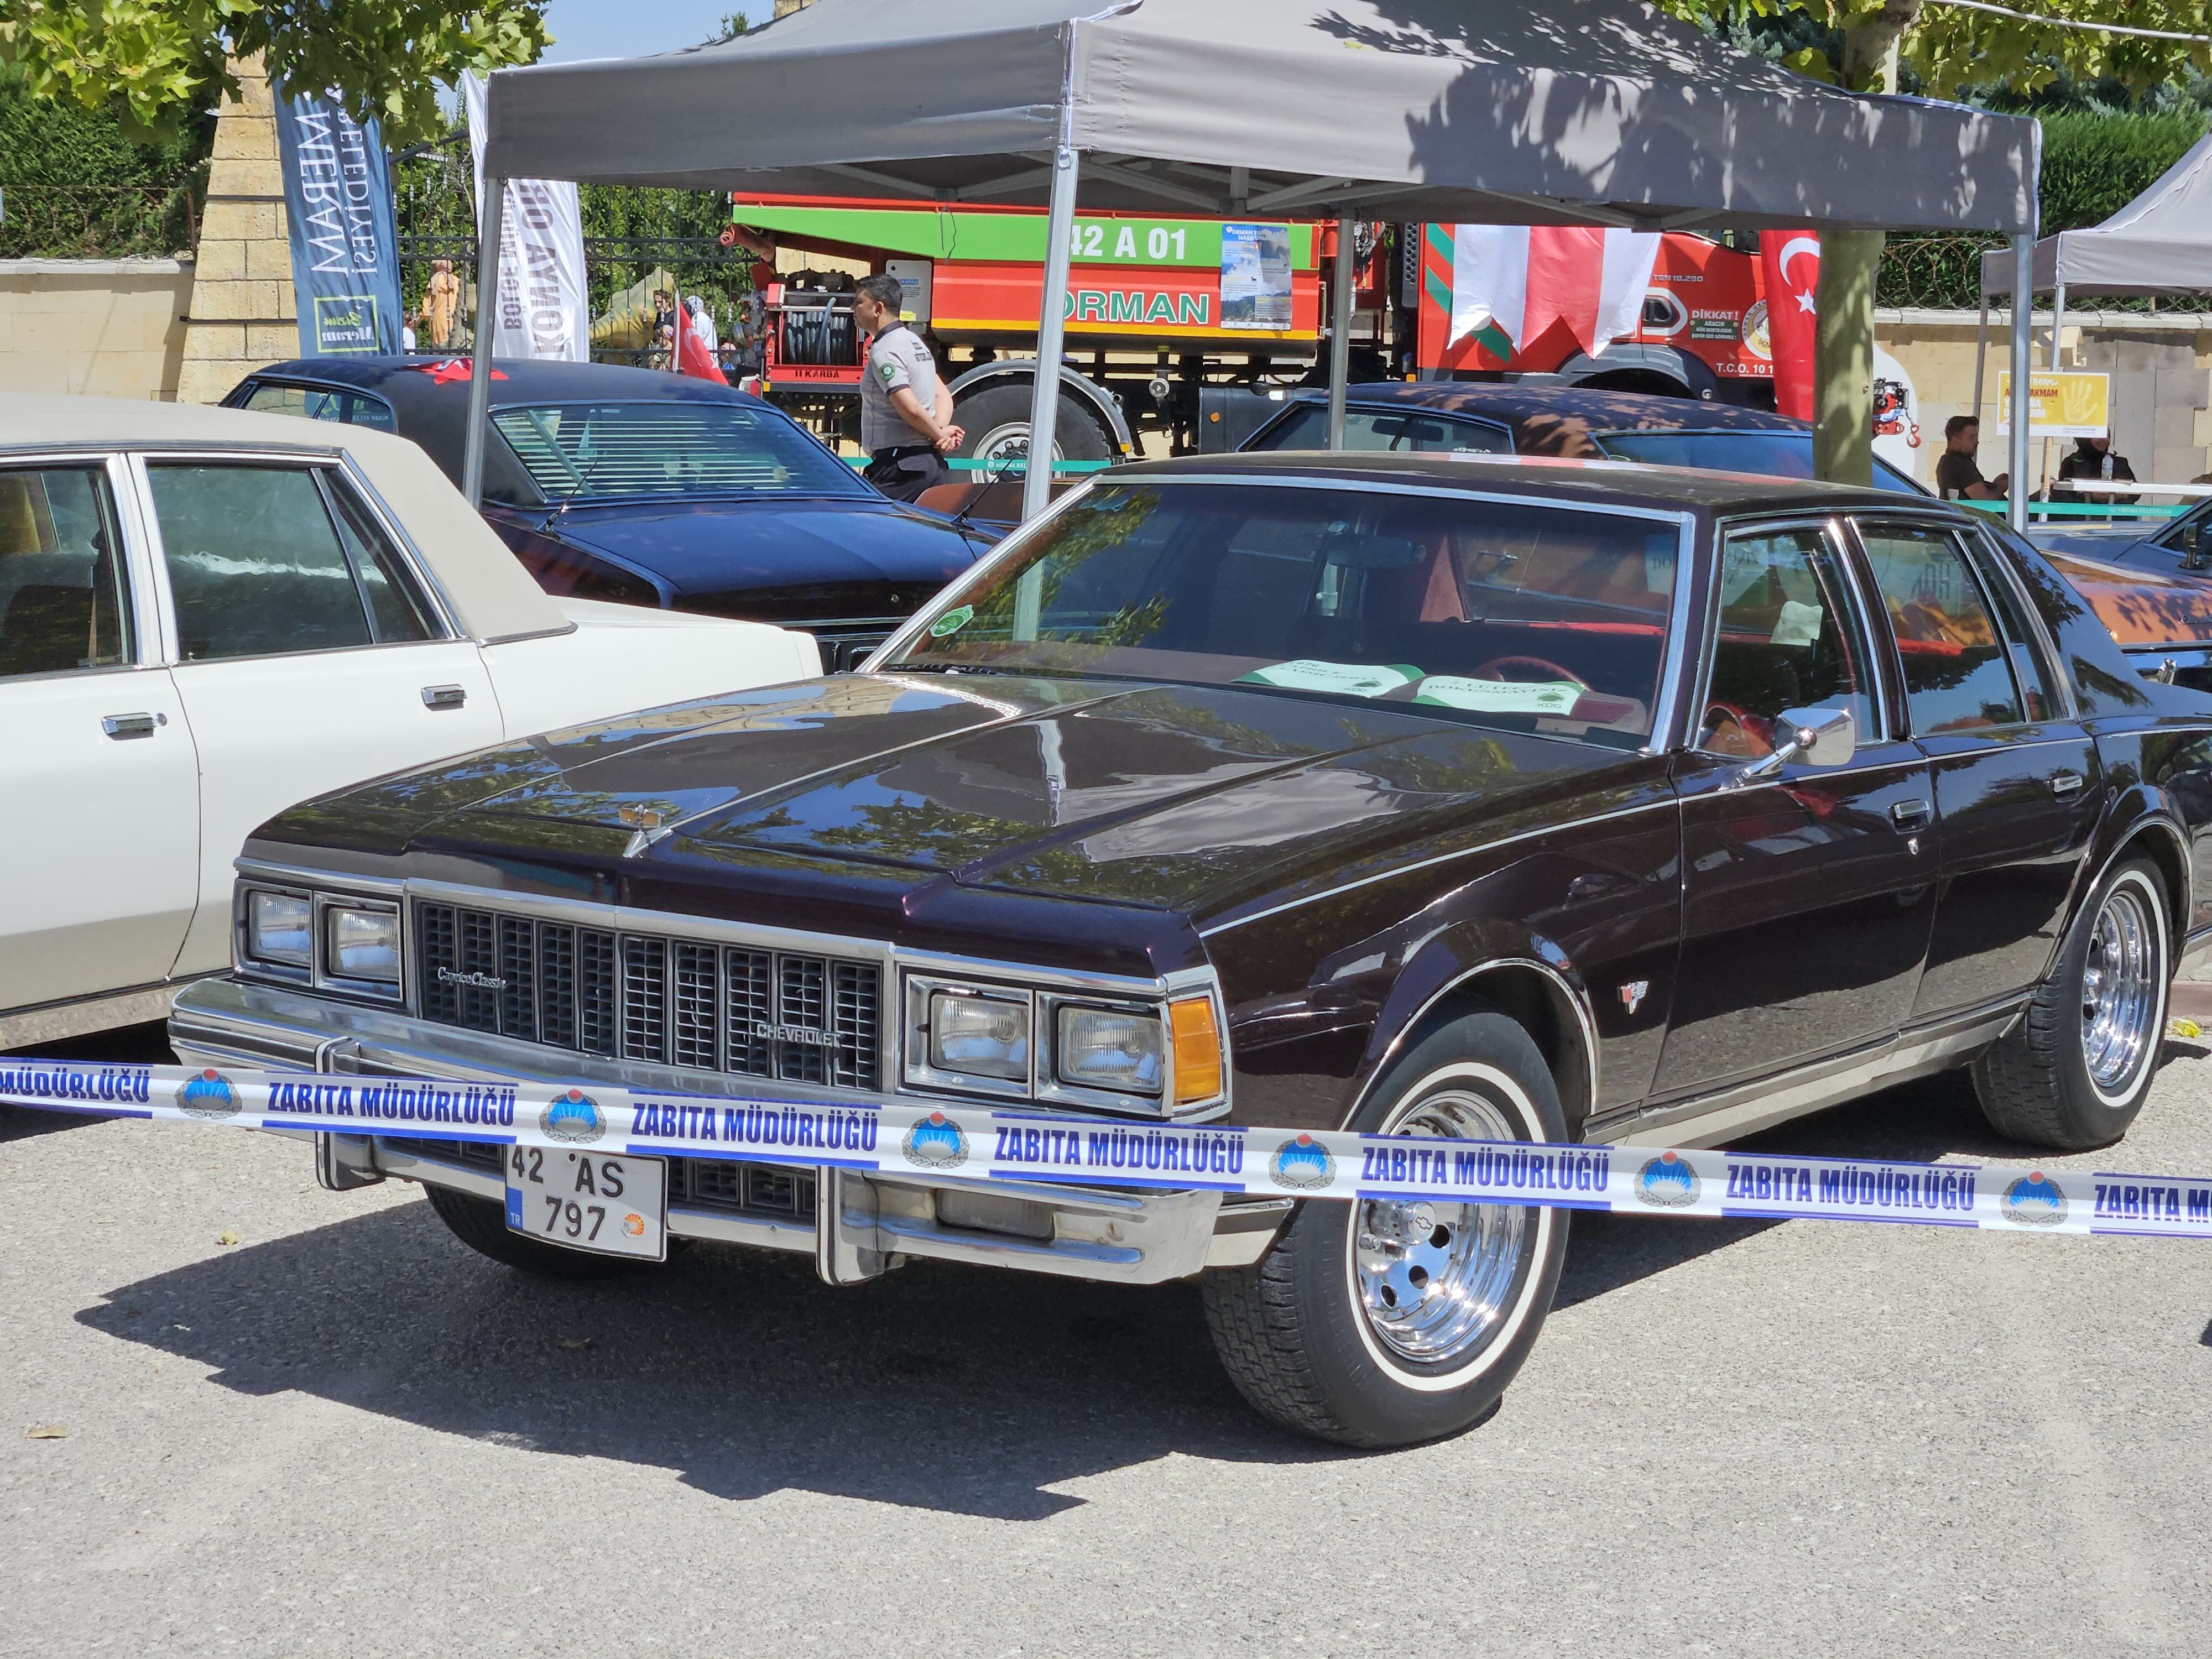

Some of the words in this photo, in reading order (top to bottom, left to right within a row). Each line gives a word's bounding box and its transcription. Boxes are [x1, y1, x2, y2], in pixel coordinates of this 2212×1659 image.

[1071, 225, 1104, 257] 42
[1114, 226, 1137, 258] A
[1148, 227, 1186, 260] 01
[1064, 290, 1209, 324] RMAN
[1692, 309, 1733, 319] DİKKAT
[2030, 389, 2058, 397] AKMAM
[437, 966, 471, 986] Caprice
[757, 1024, 841, 1048] CHEVROLET
[0, 1066, 150, 1103] MÜDÜRLÜĞÜ
[268, 1082, 354, 1116] ZABITA
[359, 1082, 516, 1126] MÜDÜRLÜĞÜ
[631, 1103, 717, 1141] ZABITA
[723, 1104, 878, 1151] MÜDÜRLÜĞÜ
[995, 1126, 1081, 1166] ZABITA
[1087, 1128, 1244, 1174] MÜDÜRLÜĞÜ
[1361, 1146, 1448, 1185] ZABITA
[1454, 1147, 1610, 1192] MÜDÜRLÜĞÜ
[512, 1145, 544, 1184] 42
[575, 1157, 625, 1198] AS
[1725, 1164, 1813, 1203] ZABITA
[1819, 1165, 1976, 1211] MÜDÜRLÜĞÜ
[510, 1212, 521, 1226] TR
[545, 1196, 606, 1240] 797
[2094, 1184, 2182, 1222] ZABITA
[2188, 1189, 2212, 1223] M
